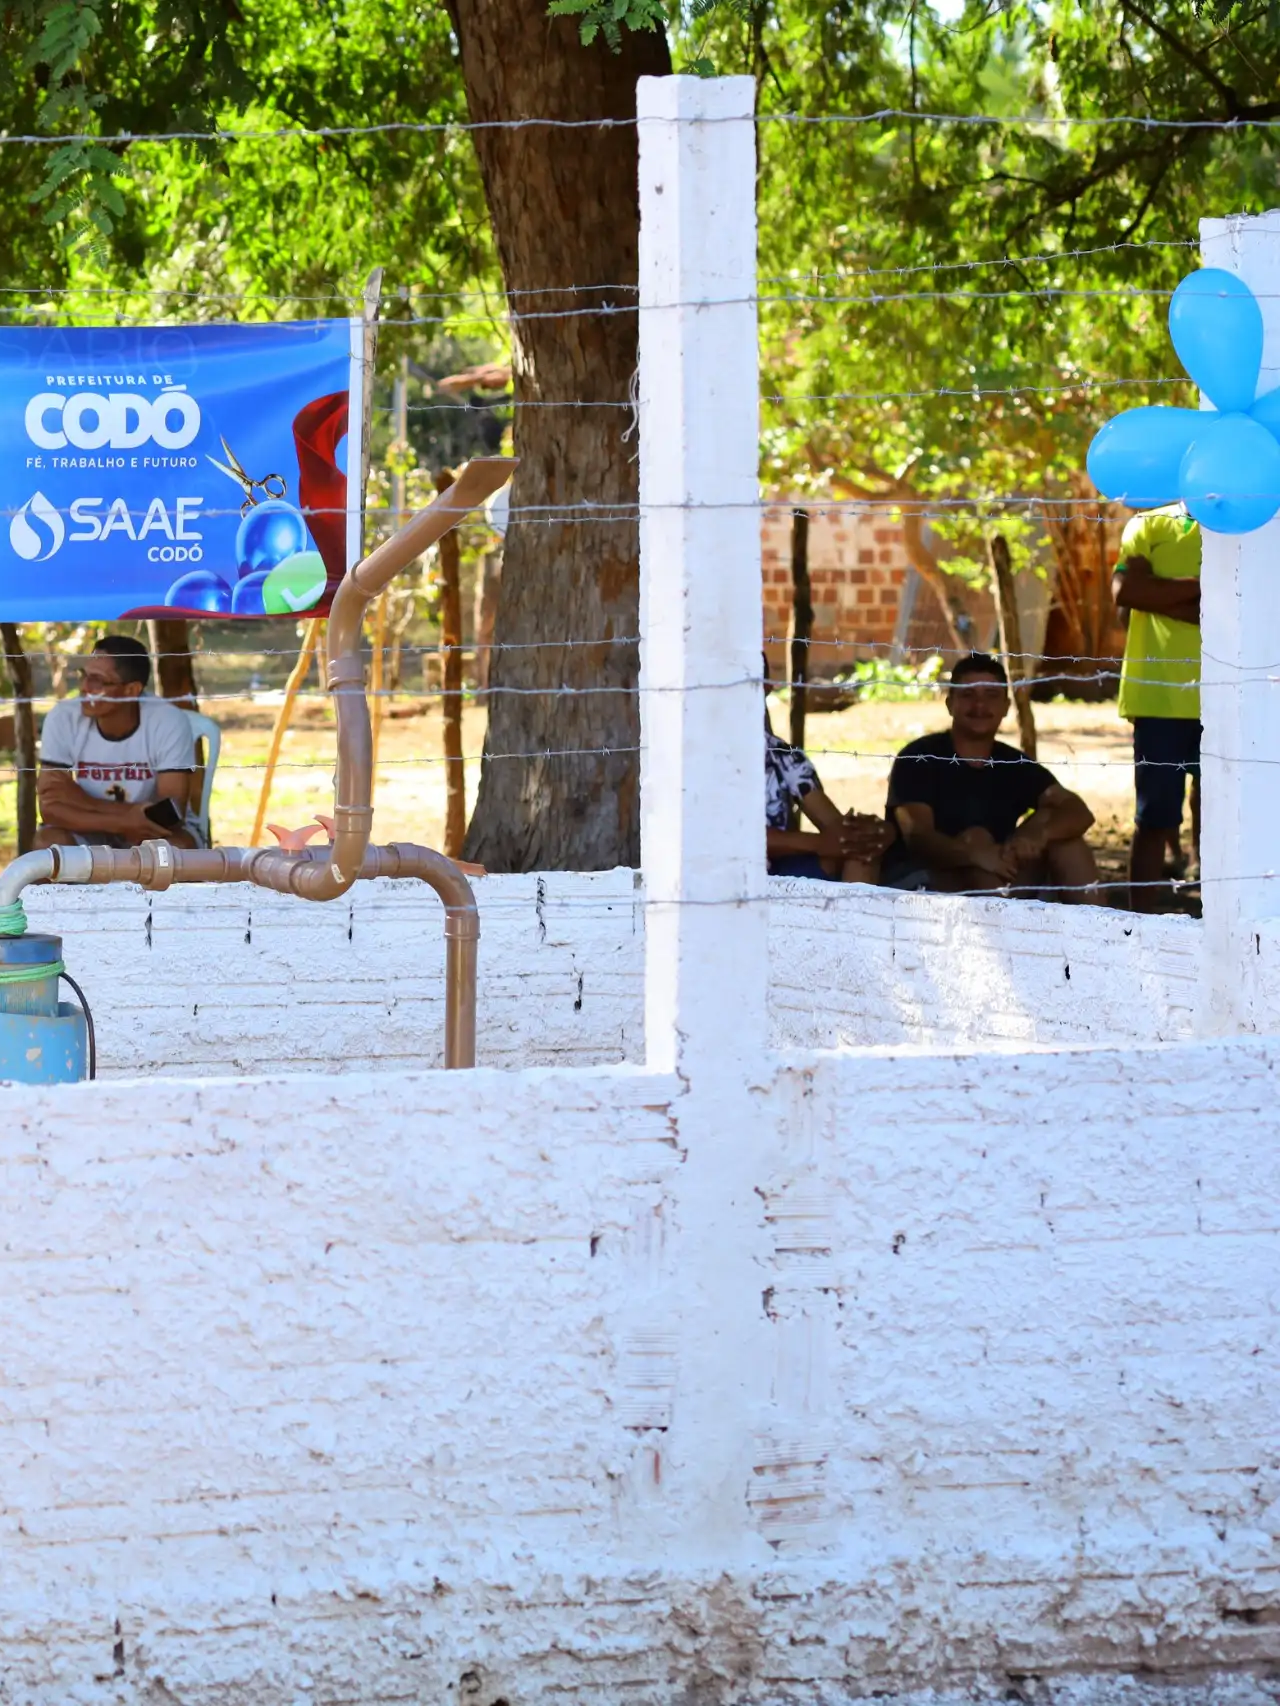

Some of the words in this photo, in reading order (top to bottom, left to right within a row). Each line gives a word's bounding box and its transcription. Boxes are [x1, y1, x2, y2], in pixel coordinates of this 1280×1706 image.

[46, 375, 147, 386] PREFEITURA
[153, 374, 174, 385] DE
[24, 384, 201, 450] CODÓ
[26, 455, 46, 469] FÉ,
[52, 457, 125, 468] TRABALHO
[131, 457, 137, 467] E
[144, 457, 197, 467] FUTURO
[69, 497, 204, 541] SAAE
[147, 543, 203, 562] CODÓ
